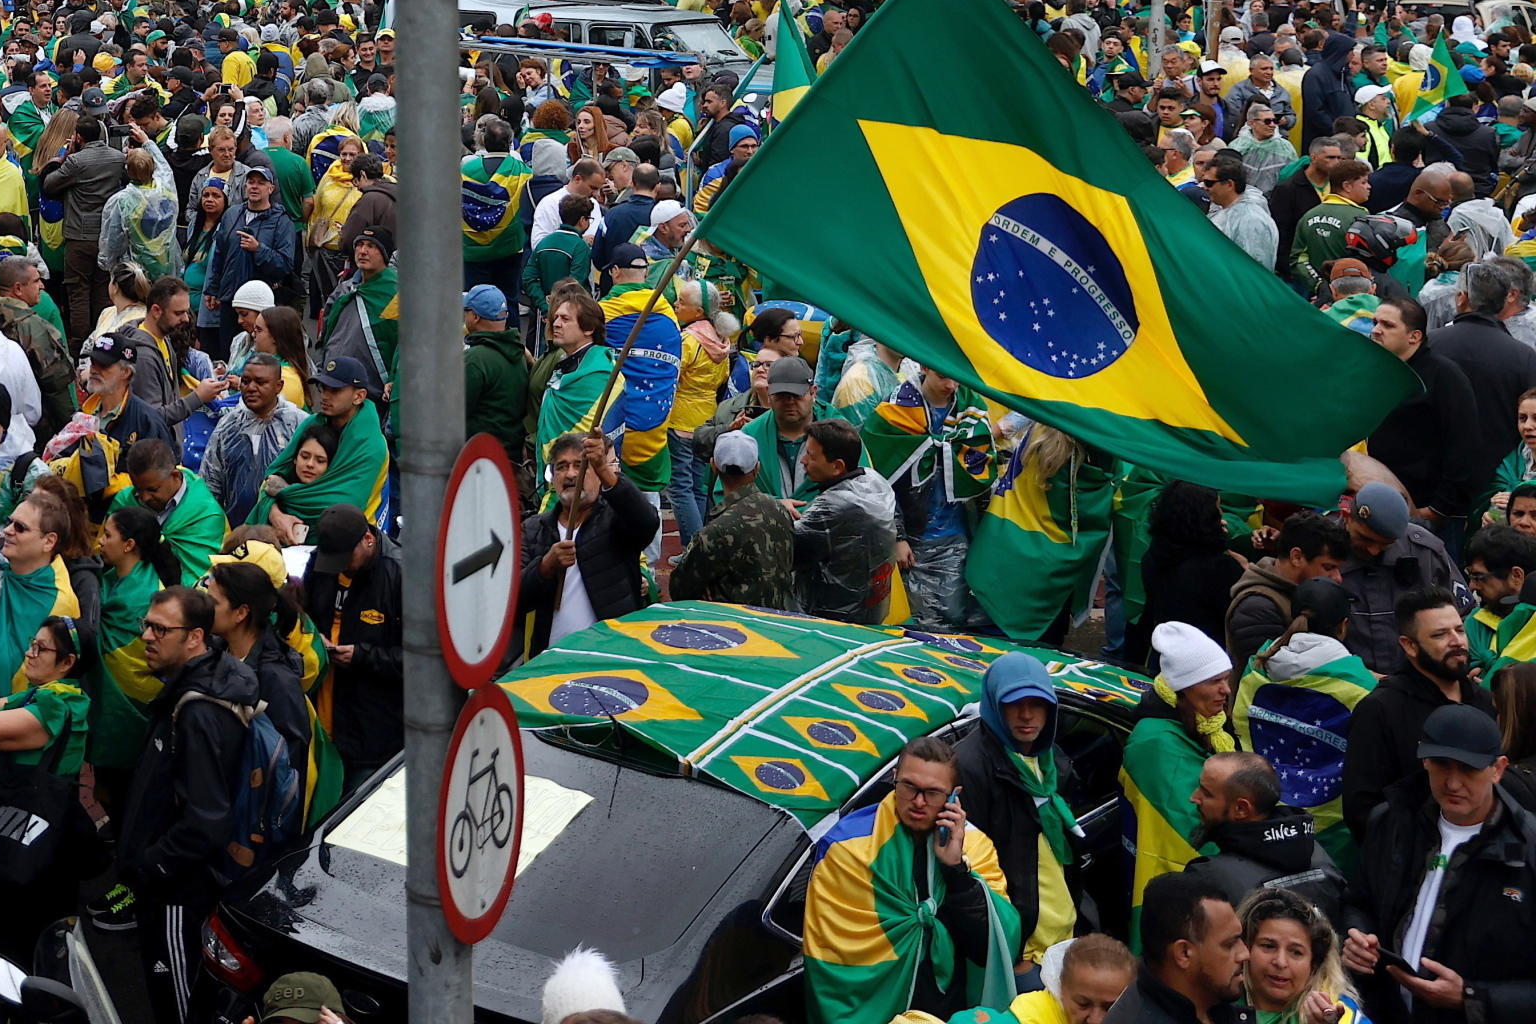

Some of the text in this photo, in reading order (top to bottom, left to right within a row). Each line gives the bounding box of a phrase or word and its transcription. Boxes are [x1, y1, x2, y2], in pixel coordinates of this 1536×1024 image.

[1307, 215, 1341, 228] BRASIL
[993, 213, 1133, 341] ORDEM E PROGRESSO
[644, 349, 682, 366] PROGRES
[1263, 823, 1298, 841] SINCE
